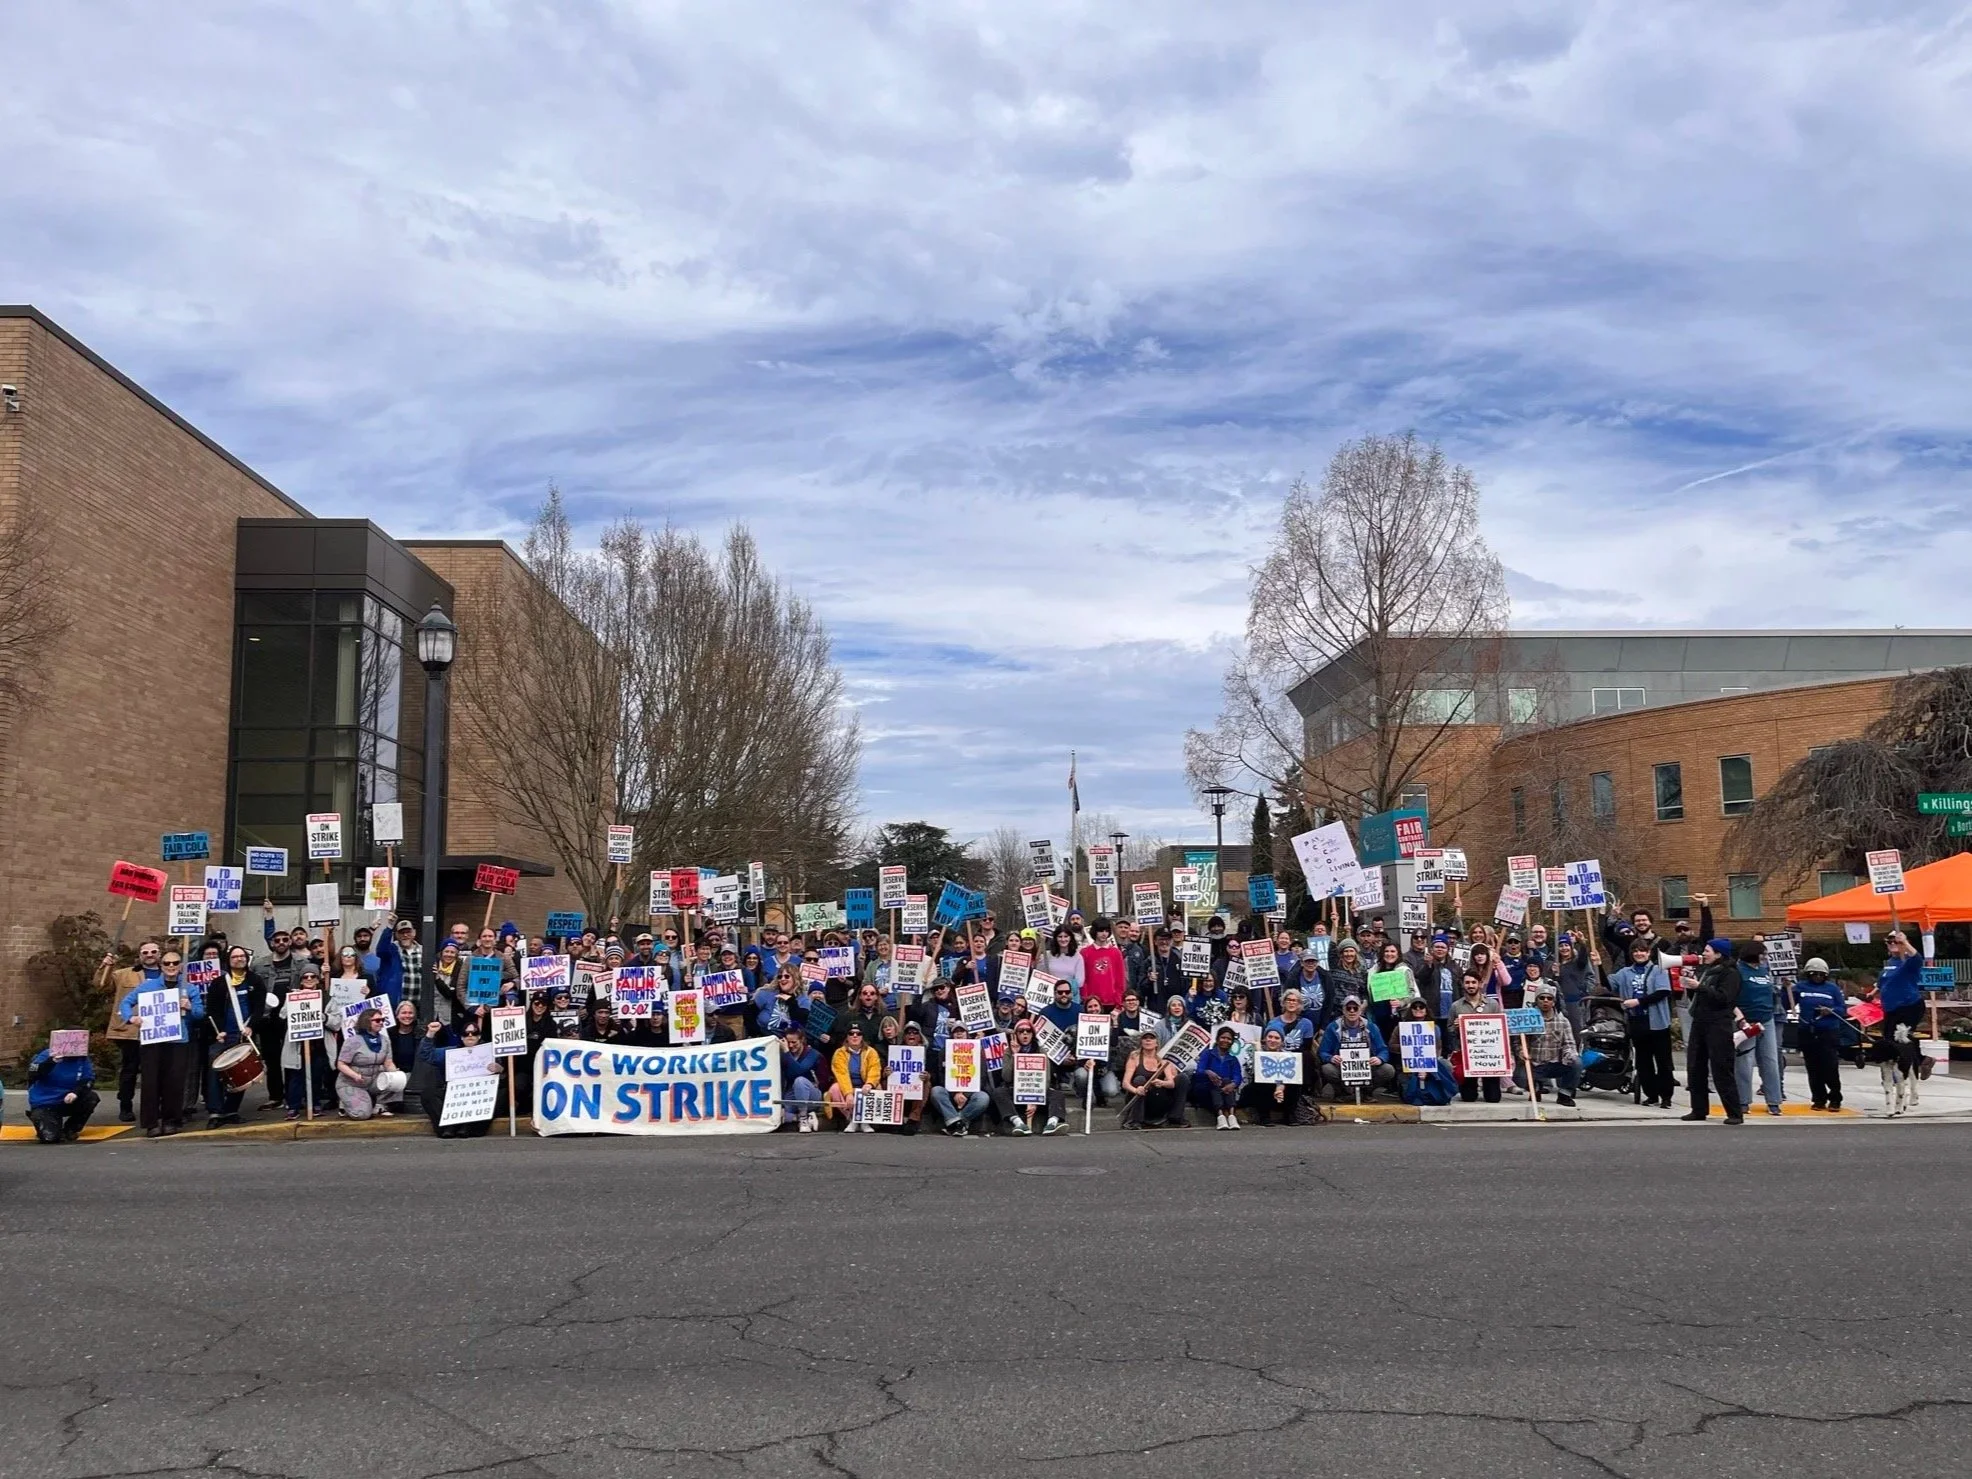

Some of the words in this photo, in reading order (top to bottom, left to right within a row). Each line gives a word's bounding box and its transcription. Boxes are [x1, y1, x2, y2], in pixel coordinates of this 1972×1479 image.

[1396, 822, 1422, 836] FAIR
[312, 832, 339, 842] STRIKE
[1398, 834, 1424, 842] CONTRACT
[164, 843, 182, 854] FAIR
[186, 842, 208, 852] COLA
[1033, 855, 1053, 864] STRIKE
[1424, 860, 1434, 869] ON
[1445, 860, 1466, 868] STRIKE
[1329, 861, 1355, 871] LIVING
[1577, 863, 1587, 873] I'D
[220, 869, 231, 878] I'D
[1416, 870, 1443, 882] STRIKE
[1567, 872, 1600, 885] RATHER
[207, 879, 241, 889] RATHER
[478, 872, 495, 884] FAIR
[496, 875, 516, 887] COLA
[680, 878, 690, 888] ON
[884, 876, 905, 884] DESERVE
[1175, 883, 1197, 892] STRIKE
[1581, 884, 1591, 894] BE
[218, 890, 228, 899] BE
[672, 889, 699, 901] STRIKE
[848, 891, 873, 899] LIVING
[884, 890, 906, 898] RESPECT
[1136, 892, 1160, 901] DESERVE
[715, 901, 737, 912] STRIKE
[805, 904, 826, 912] PCC
[1026, 902, 1048, 914] STRIKE
[1137, 907, 1161, 916] RESPECT
[1403, 912, 1426, 920] STRIKE
[549, 919, 583, 930] RESPECT
[842, 948, 850, 957] IS
[1192, 944, 1201, 952] ON
[1183, 953, 1209, 963] STRIKE
[1768, 951, 1794, 961] STRIKE
[203, 961, 213, 970] IS
[1237, 966, 1246, 974] ON
[620, 968, 645, 978] ADMIN
[647, 968, 656, 977] IS
[525, 974, 566, 988] STUDENTS
[616, 977, 661, 990] FAILING
[702, 974, 727, 987] ADMIN
[728, 971, 738, 981] IS
[1925, 974, 1953, 984] STRIKE
[1038, 983, 1049, 993] ON
[153, 992, 165, 1004] I'D
[616, 990, 656, 1001] STUDENTS
[675, 993, 697, 1003] CHOP
[960, 993, 987, 1006] DESERVE
[1027, 991, 1053, 1004] STRIKE
[140, 1002, 178, 1016] RATHER
[300, 1002, 310, 1010] ON
[345, 1000, 371, 1018] ADMIN
[373, 997, 383, 1008] IS
[675, 1005, 697, 1015] FROM
[154, 1015, 166, 1027] BE
[291, 1011, 320, 1023] STRIKE
[963, 1010, 991, 1023] RESPECT
[1506, 1014, 1541, 1027] ESPECT
[503, 1017, 515, 1030] ON
[680, 1027, 695, 1038] TOP
[1040, 1029, 1050, 1039] ON
[1088, 1025, 1100, 1034] ON
[1411, 1024, 1422, 1034] I'D
[494, 1029, 525, 1044] STRIKE
[1079, 1033, 1108, 1046] STRIKE
[1401, 1035, 1434, 1046] RATHER
[953, 1043, 975, 1053] CHOP
[1413, 1047, 1424, 1057] BE
[901, 1049, 912, 1060] I'D
[953, 1055, 974, 1064] FROM
[1350, 1051, 1360, 1059] ON
[543, 1049, 602, 1078] PCC
[613, 1047, 768, 1075] WORKERS
[890, 1061, 923, 1072] RATHER
[1342, 1061, 1369, 1071] STRIKE
[957, 1065, 971, 1074] THE
[900, 1073, 912, 1084] BE
[956, 1076, 972, 1087] TOP
[541, 1081, 601, 1121] ON
[612, 1079, 773, 1124] STRIKE
[864, 1092, 875, 1122] RESPECT
[882, 1093, 893, 1122] DESERVE
[443, 1109, 472, 1121] JOIN
[475, 1108, 491, 1117] US
